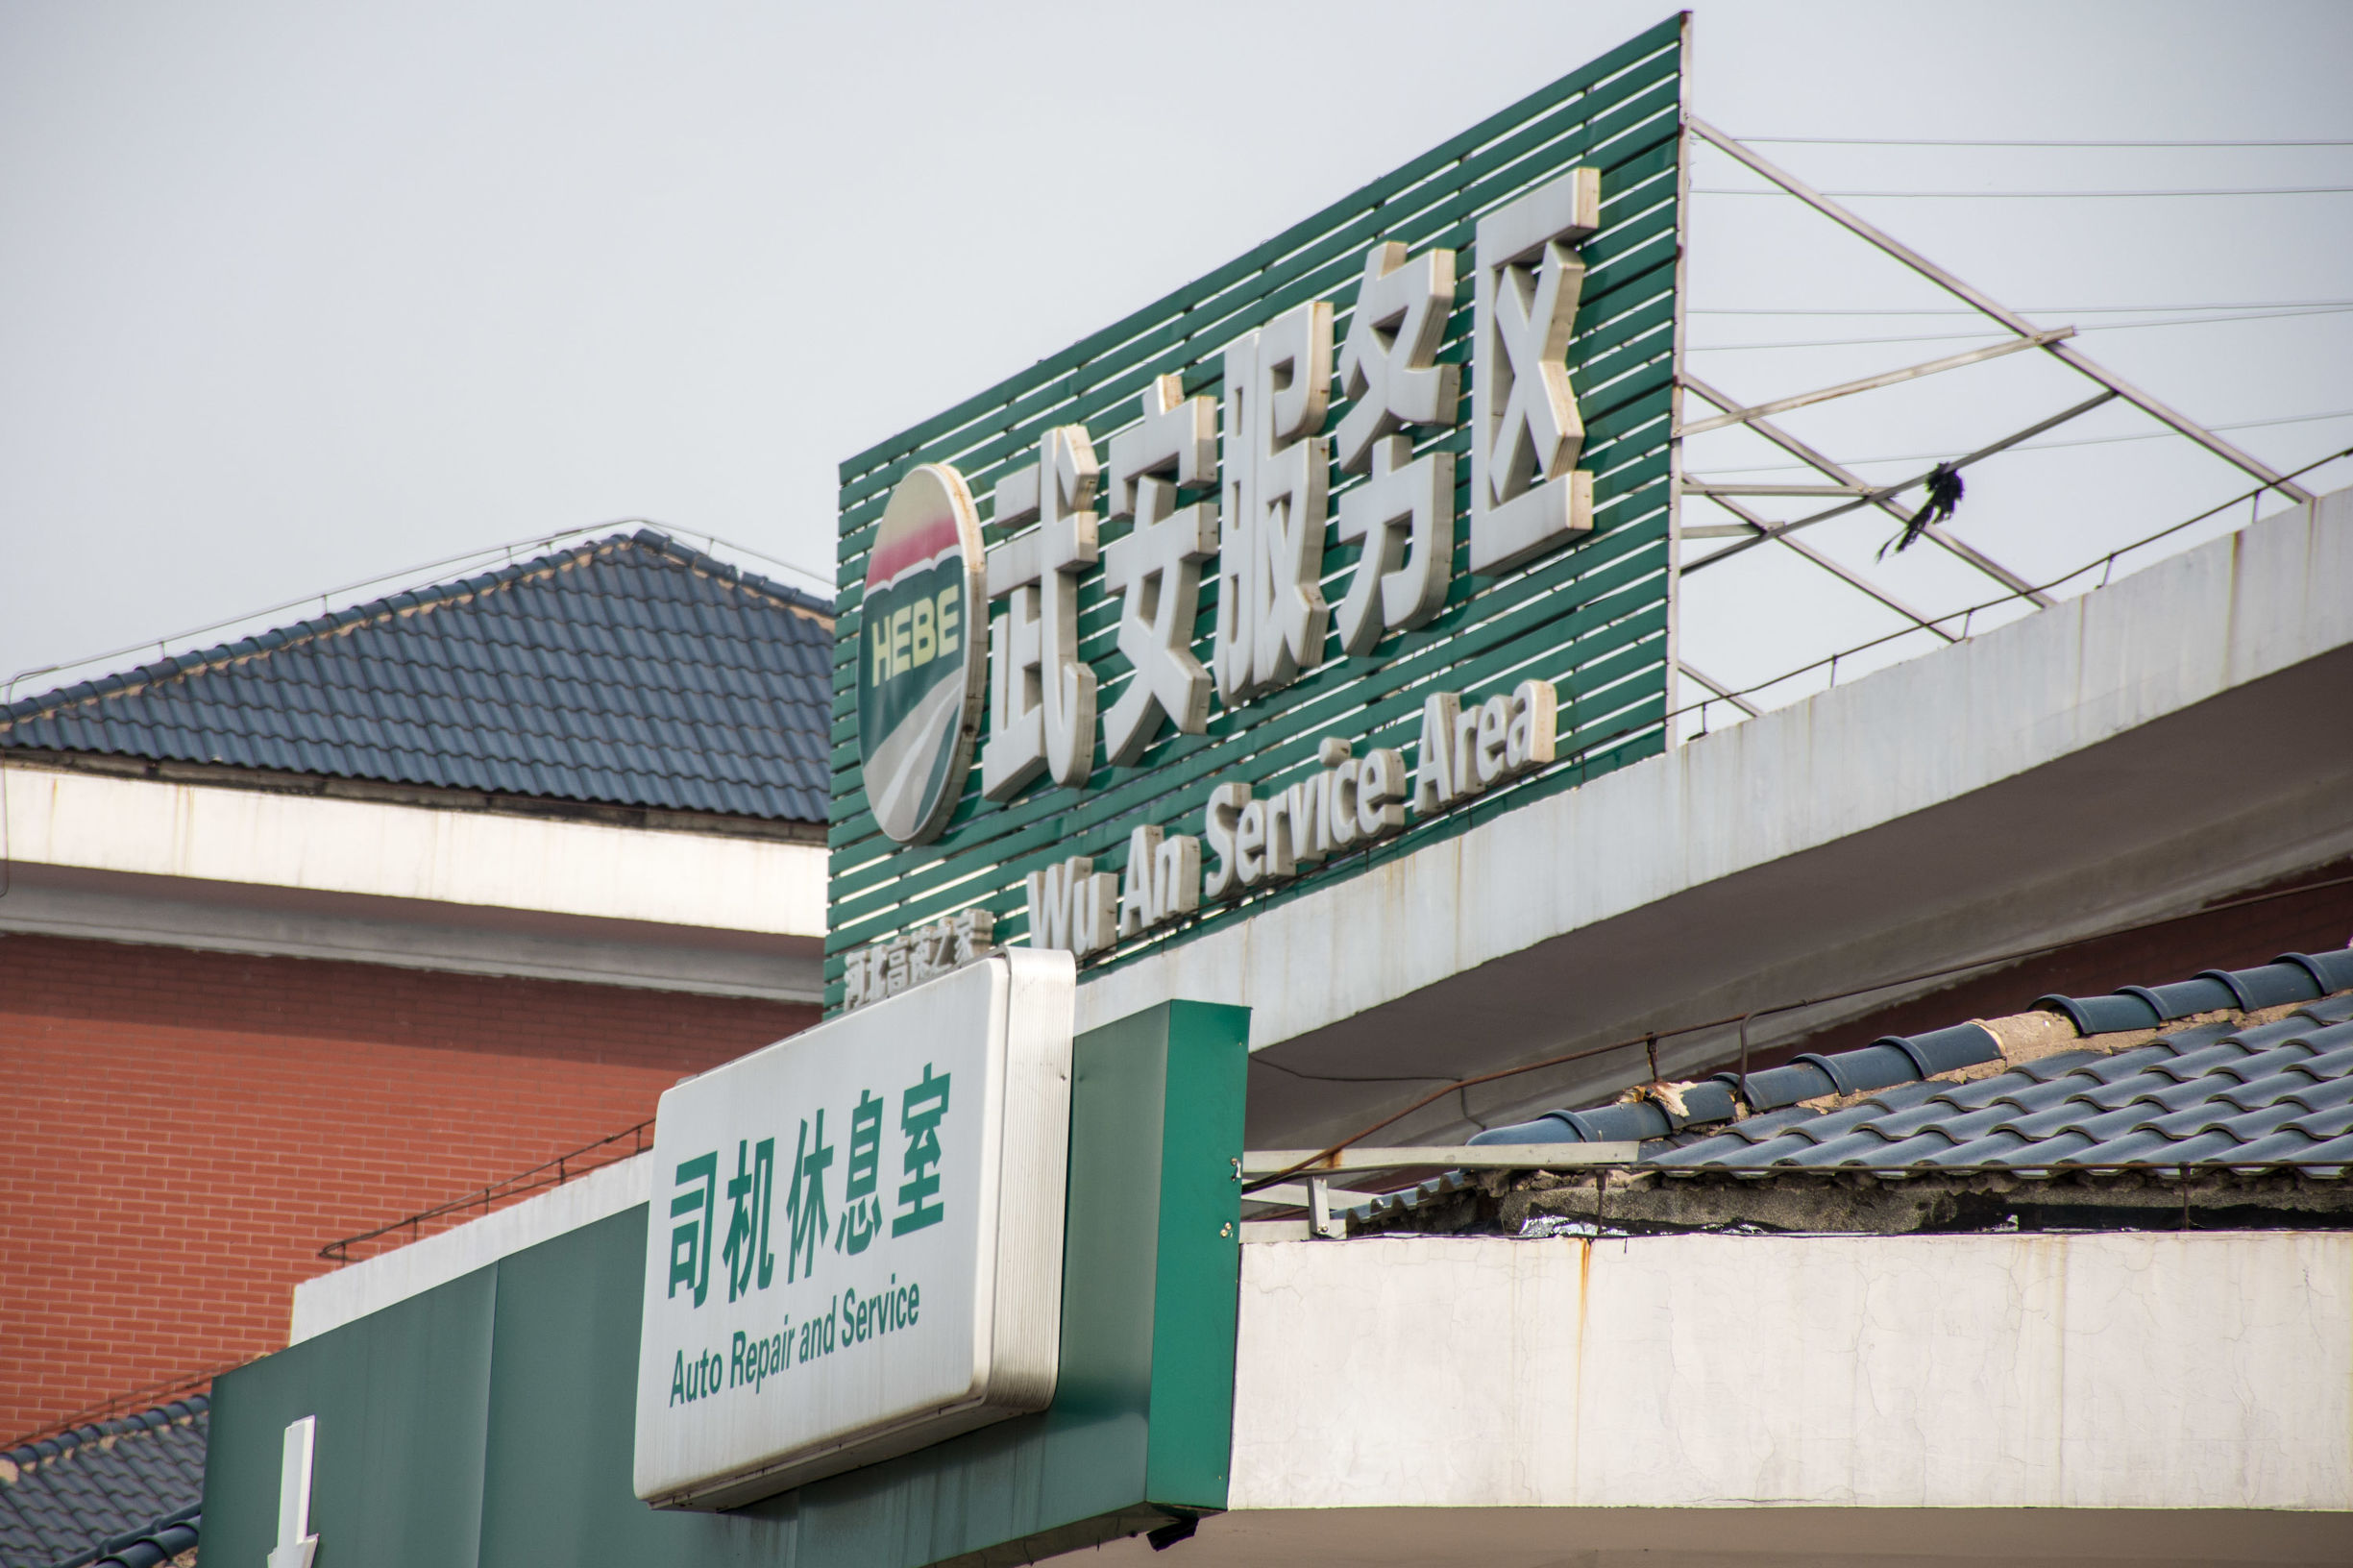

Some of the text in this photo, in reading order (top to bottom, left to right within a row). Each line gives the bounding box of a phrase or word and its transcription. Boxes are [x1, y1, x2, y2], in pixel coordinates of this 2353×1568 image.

[982, 167, 1601, 801] 武安服务区
[1026, 679, 1557, 957] Wu An Service Area
[668, 1062, 951, 1310] 司机休息室
[669, 1273, 919, 1408] Auto Repair and Service
